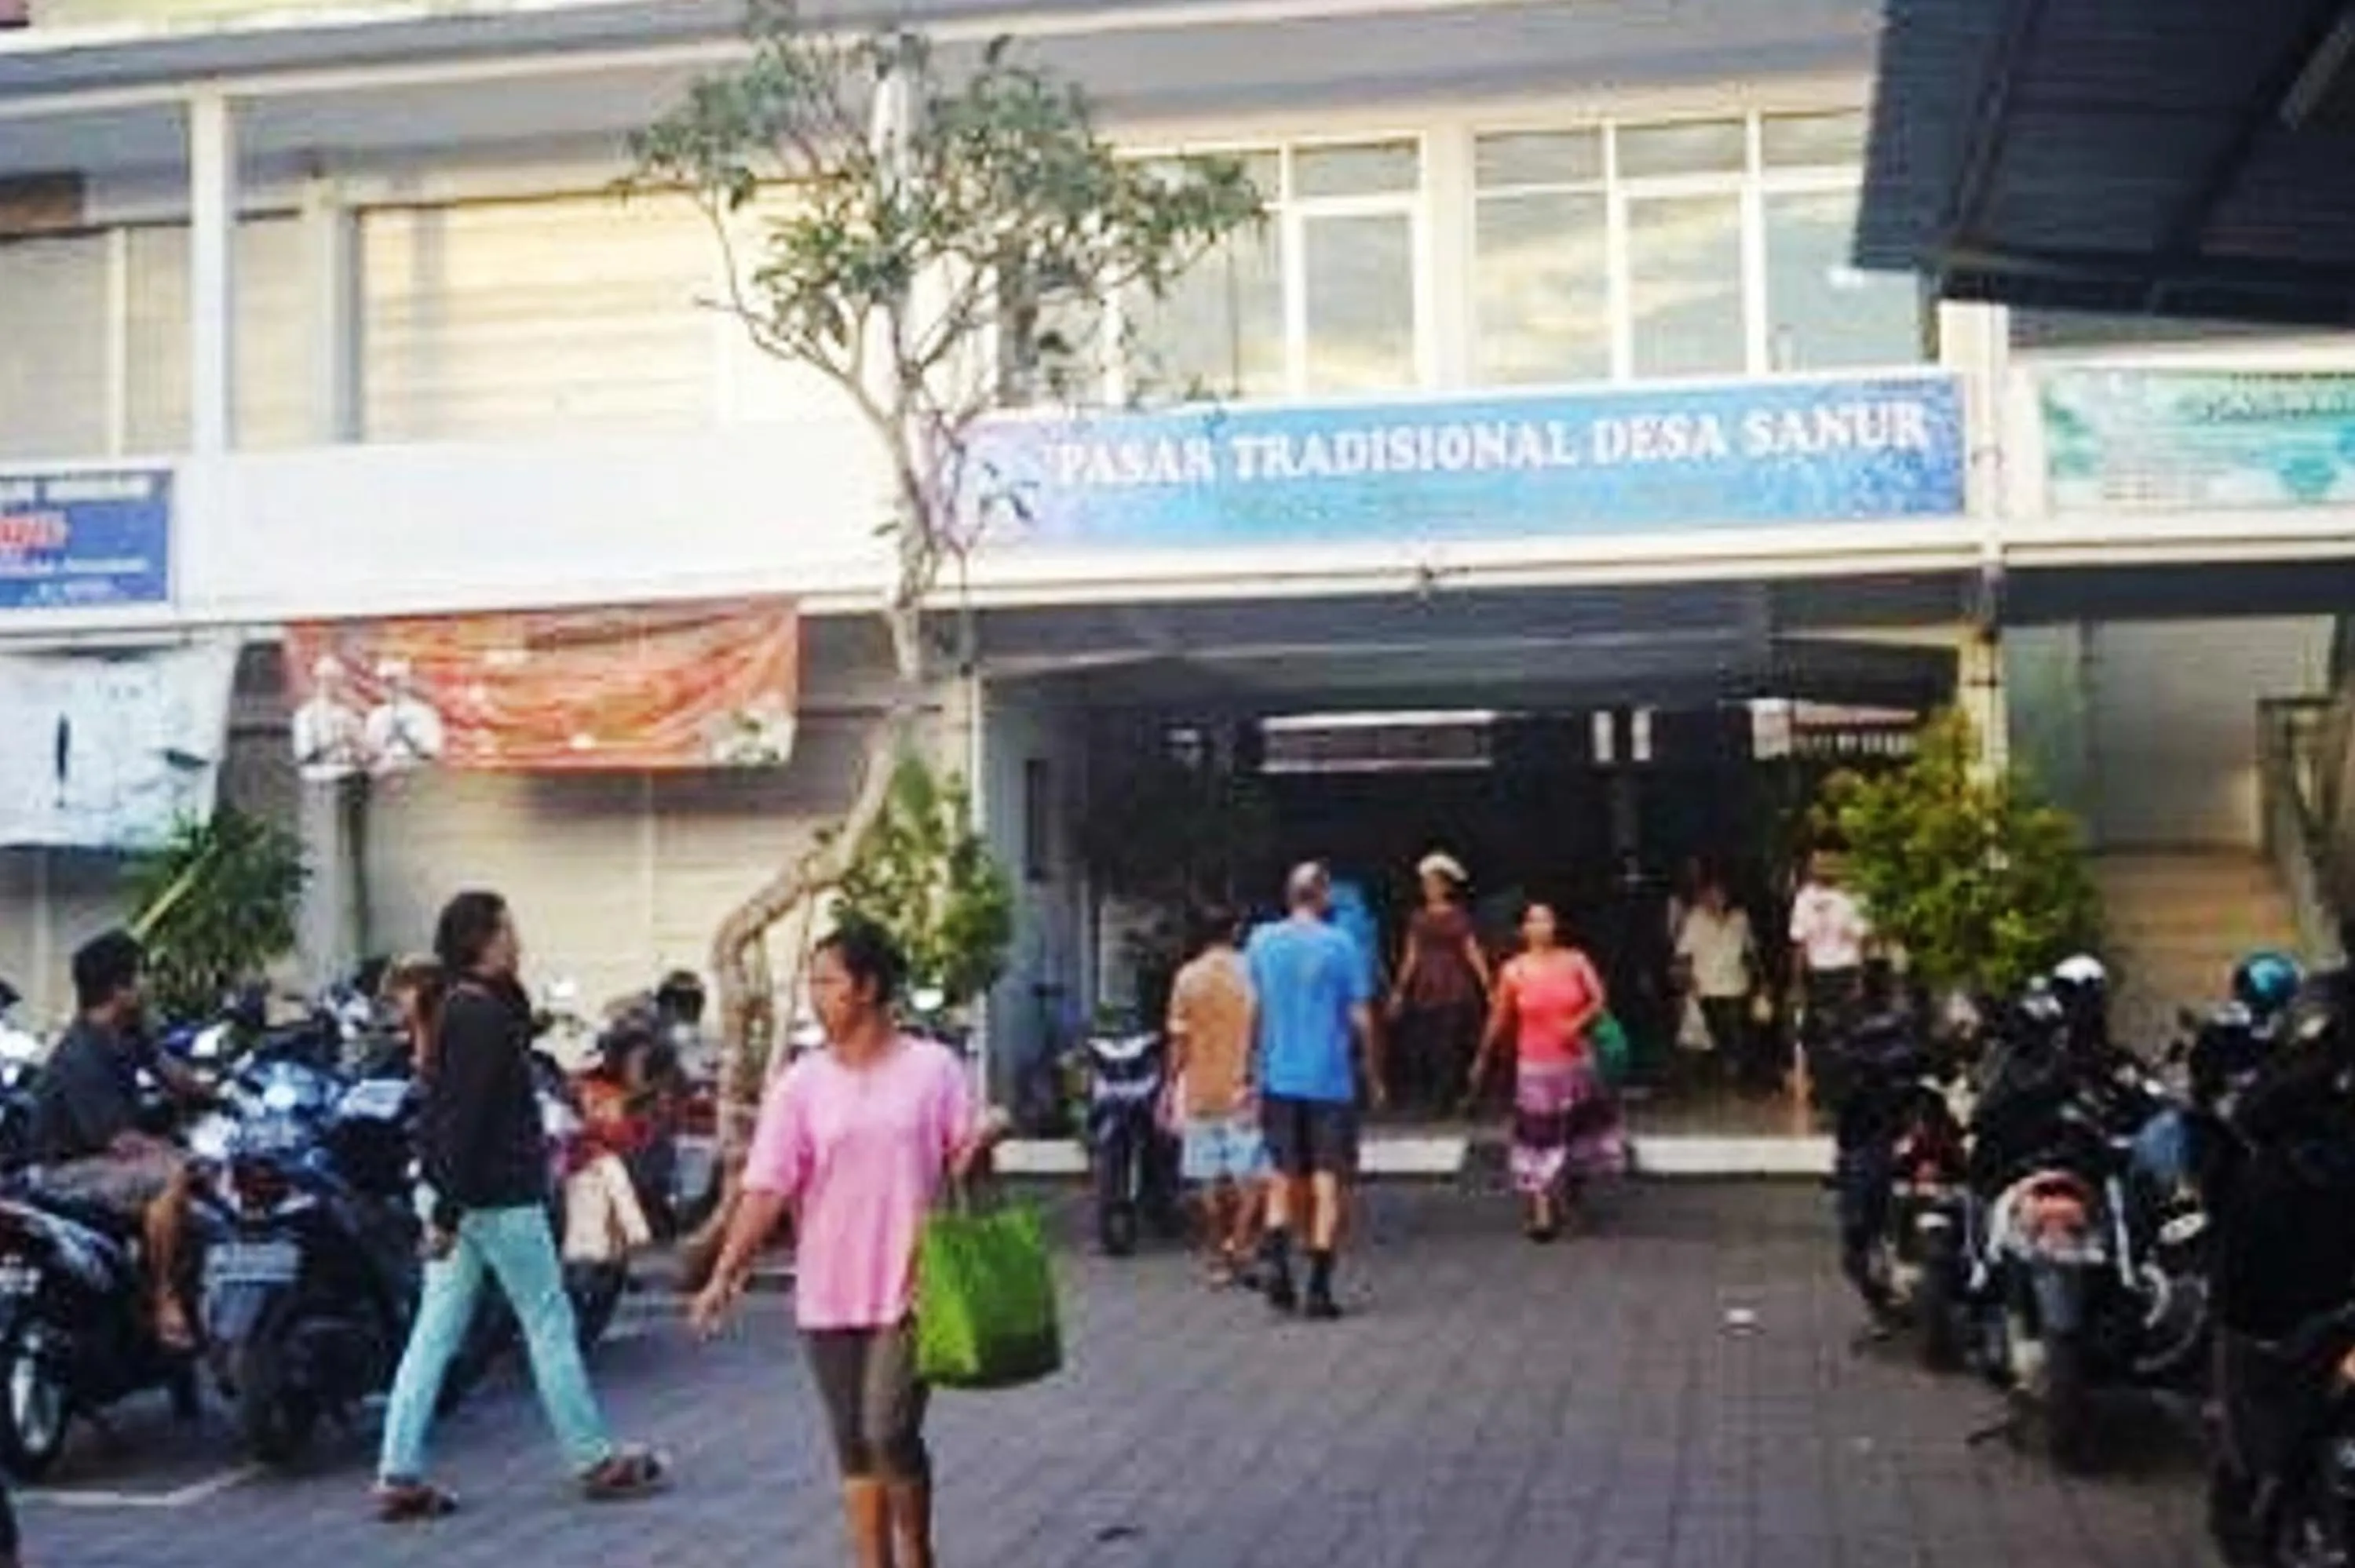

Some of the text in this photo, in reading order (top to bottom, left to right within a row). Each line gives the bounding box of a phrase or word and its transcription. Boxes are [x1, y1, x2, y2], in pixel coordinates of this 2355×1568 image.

[1056, 399, 1930, 485] PASAR TRADISIONAL DESA SANUR
